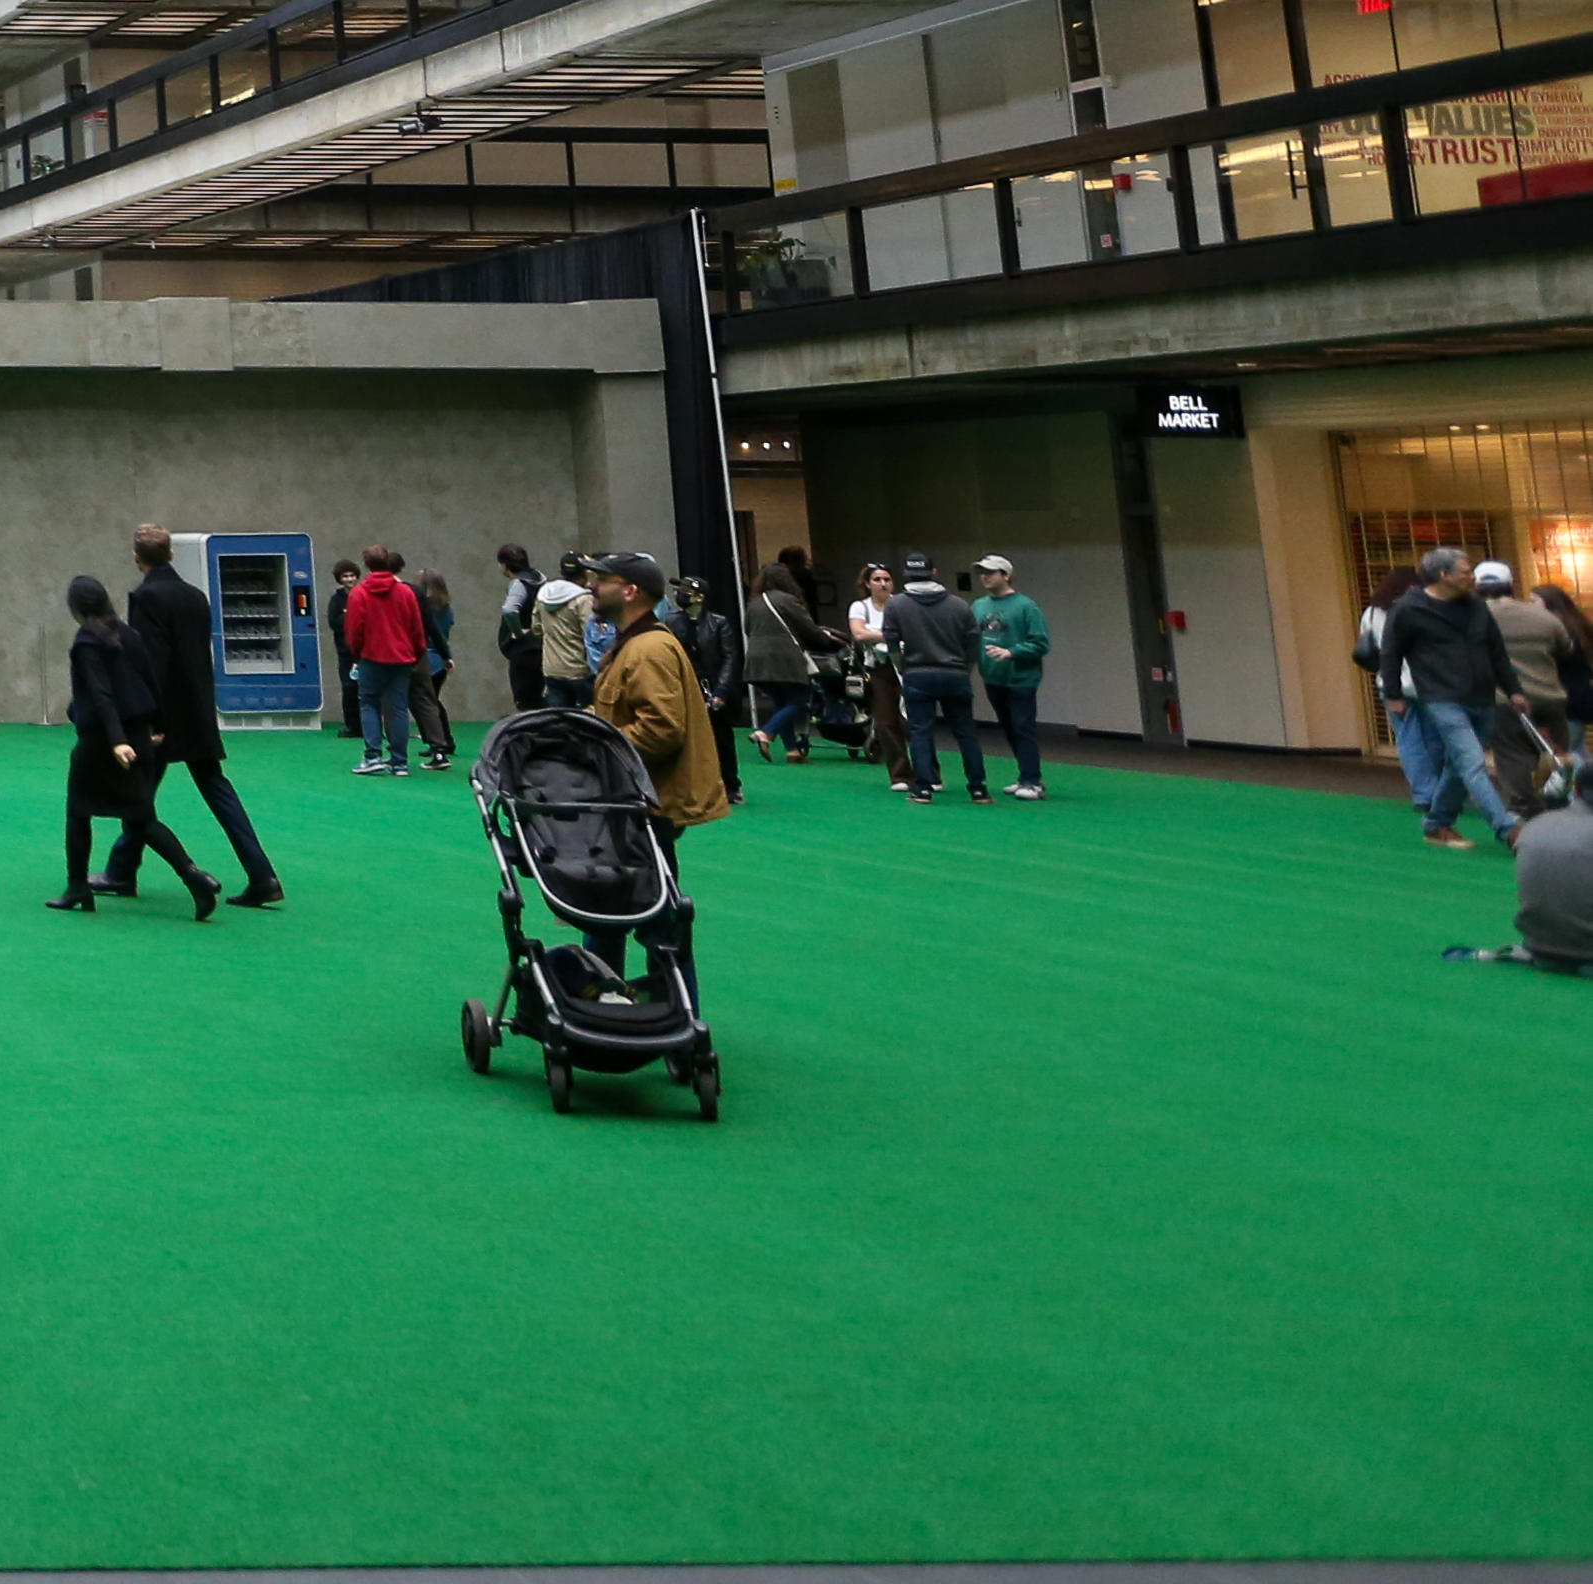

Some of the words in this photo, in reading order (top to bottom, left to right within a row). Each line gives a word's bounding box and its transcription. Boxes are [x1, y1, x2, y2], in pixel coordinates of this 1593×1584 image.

[1423, 137, 1513, 166] TRUST
[1168, 395, 1209, 411] BELL
[1158, 412, 1220, 429] MARKET
